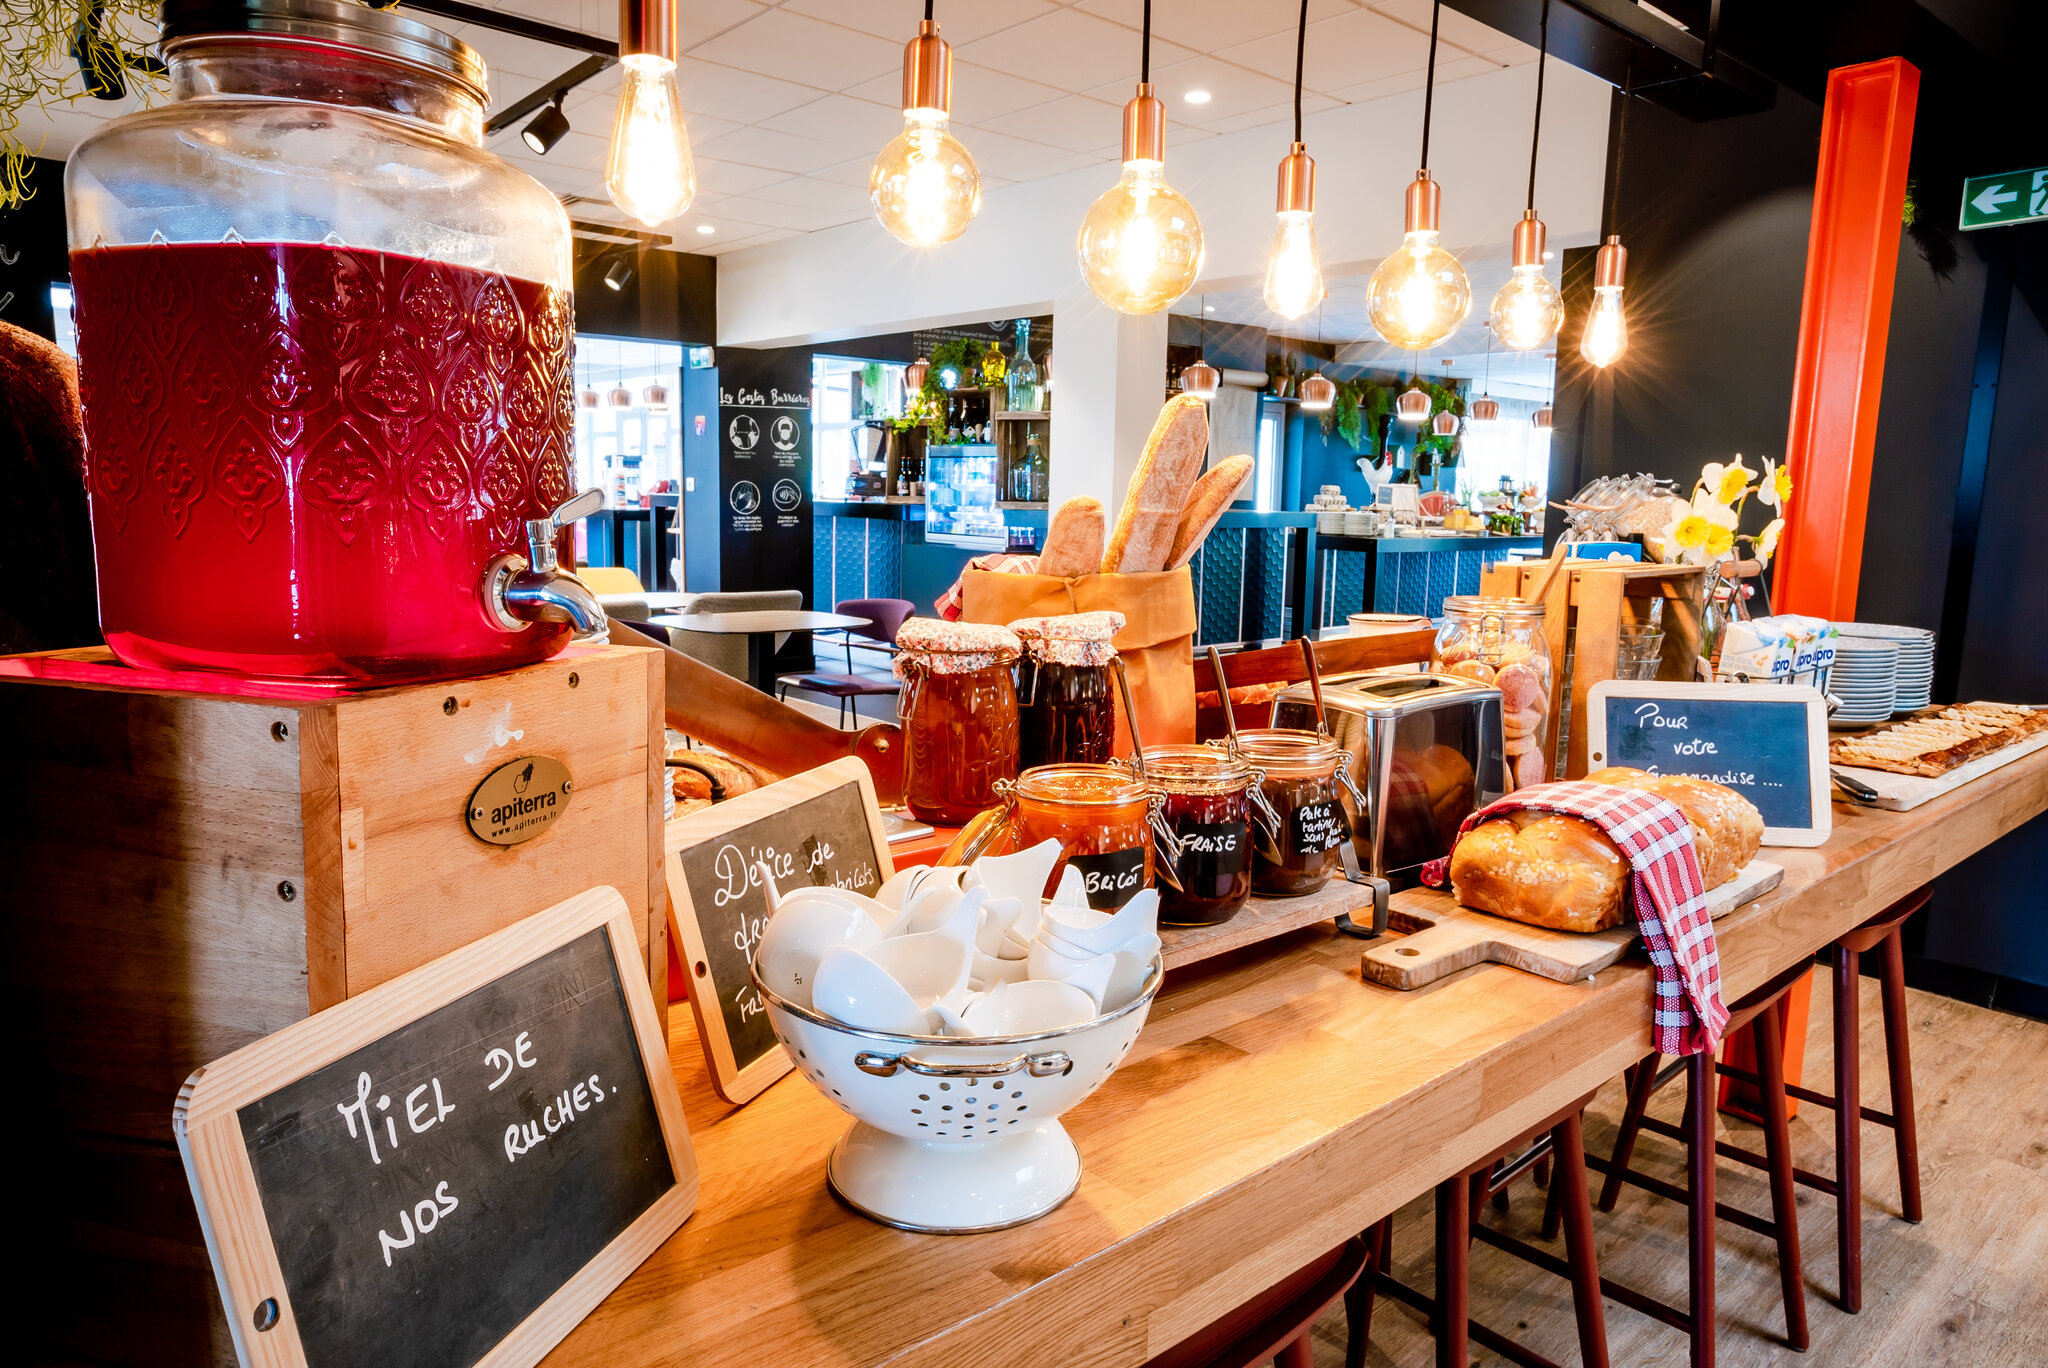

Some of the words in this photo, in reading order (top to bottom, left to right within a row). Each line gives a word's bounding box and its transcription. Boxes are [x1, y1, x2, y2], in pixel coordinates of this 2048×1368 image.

[719, 386, 734, 405] Les
[737, 387, 766, 406] Gestes
[1673, 738, 1719, 756] votre
[491, 791, 557, 826] apiterra
[491, 810, 558, 838] www.apiterra.fr
[1303, 832, 1324, 843] sans
[806, 841, 835, 873] de
[484, 1031, 538, 1091] DE
[379, 1180, 459, 1268] NOS
